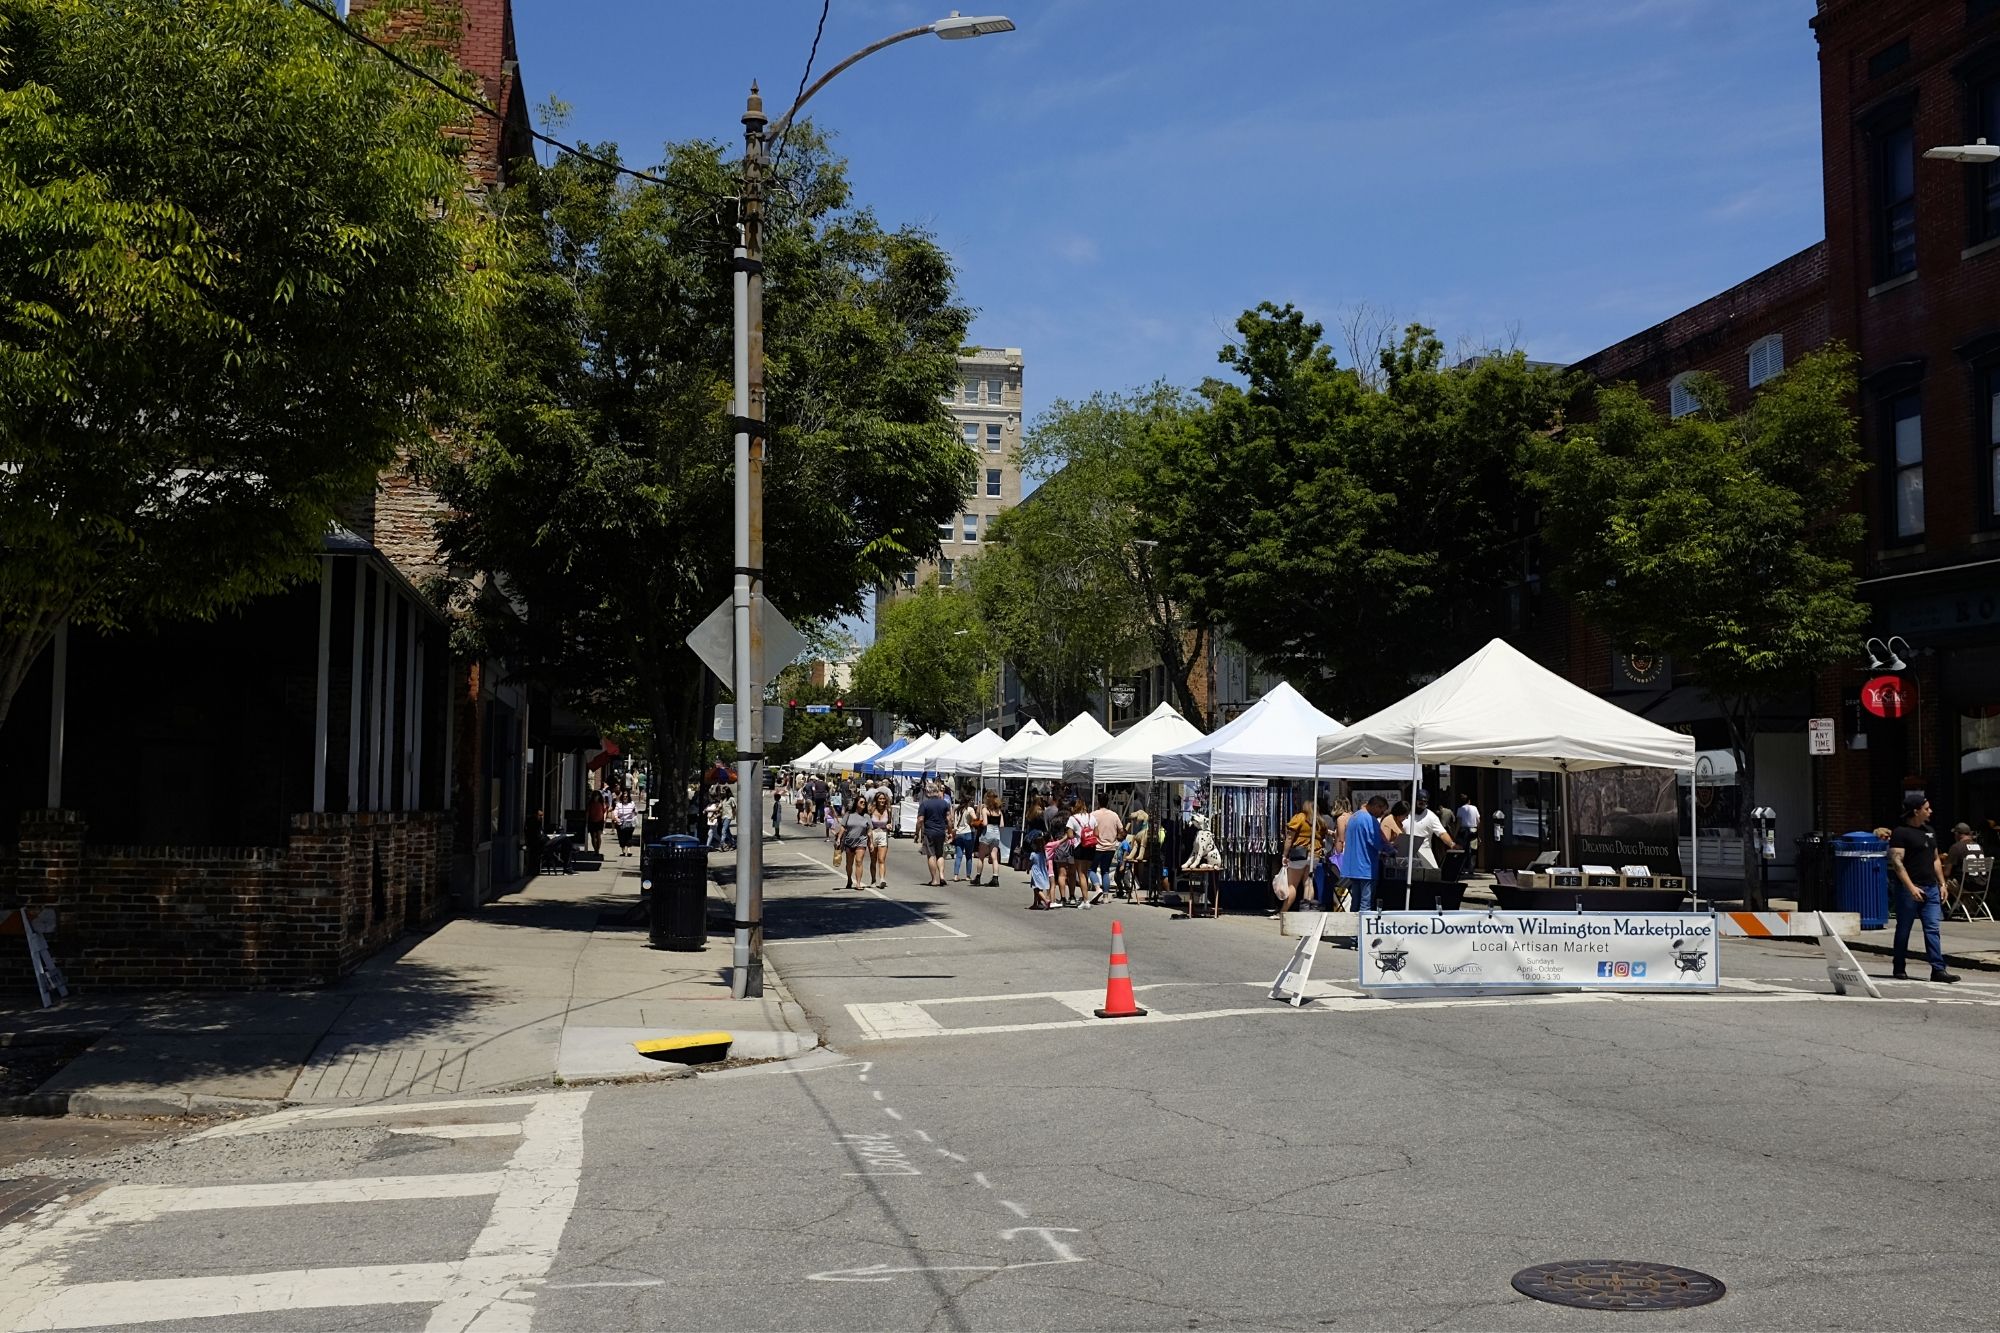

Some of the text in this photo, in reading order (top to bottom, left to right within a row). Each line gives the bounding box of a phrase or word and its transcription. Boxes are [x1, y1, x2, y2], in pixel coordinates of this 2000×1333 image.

[1615, 840, 1637, 855] DOUG
[1638, 841, 1669, 857] PHOTOS
[1366, 917, 1711, 940] Historic Downtown Wilmington Marketplace
[1472, 941, 1609, 953] Local Artisan Market
[1526, 957, 1555, 966] Sundays
[1517, 965, 1533, 974] April
[1538, 965, 1564, 973] October
